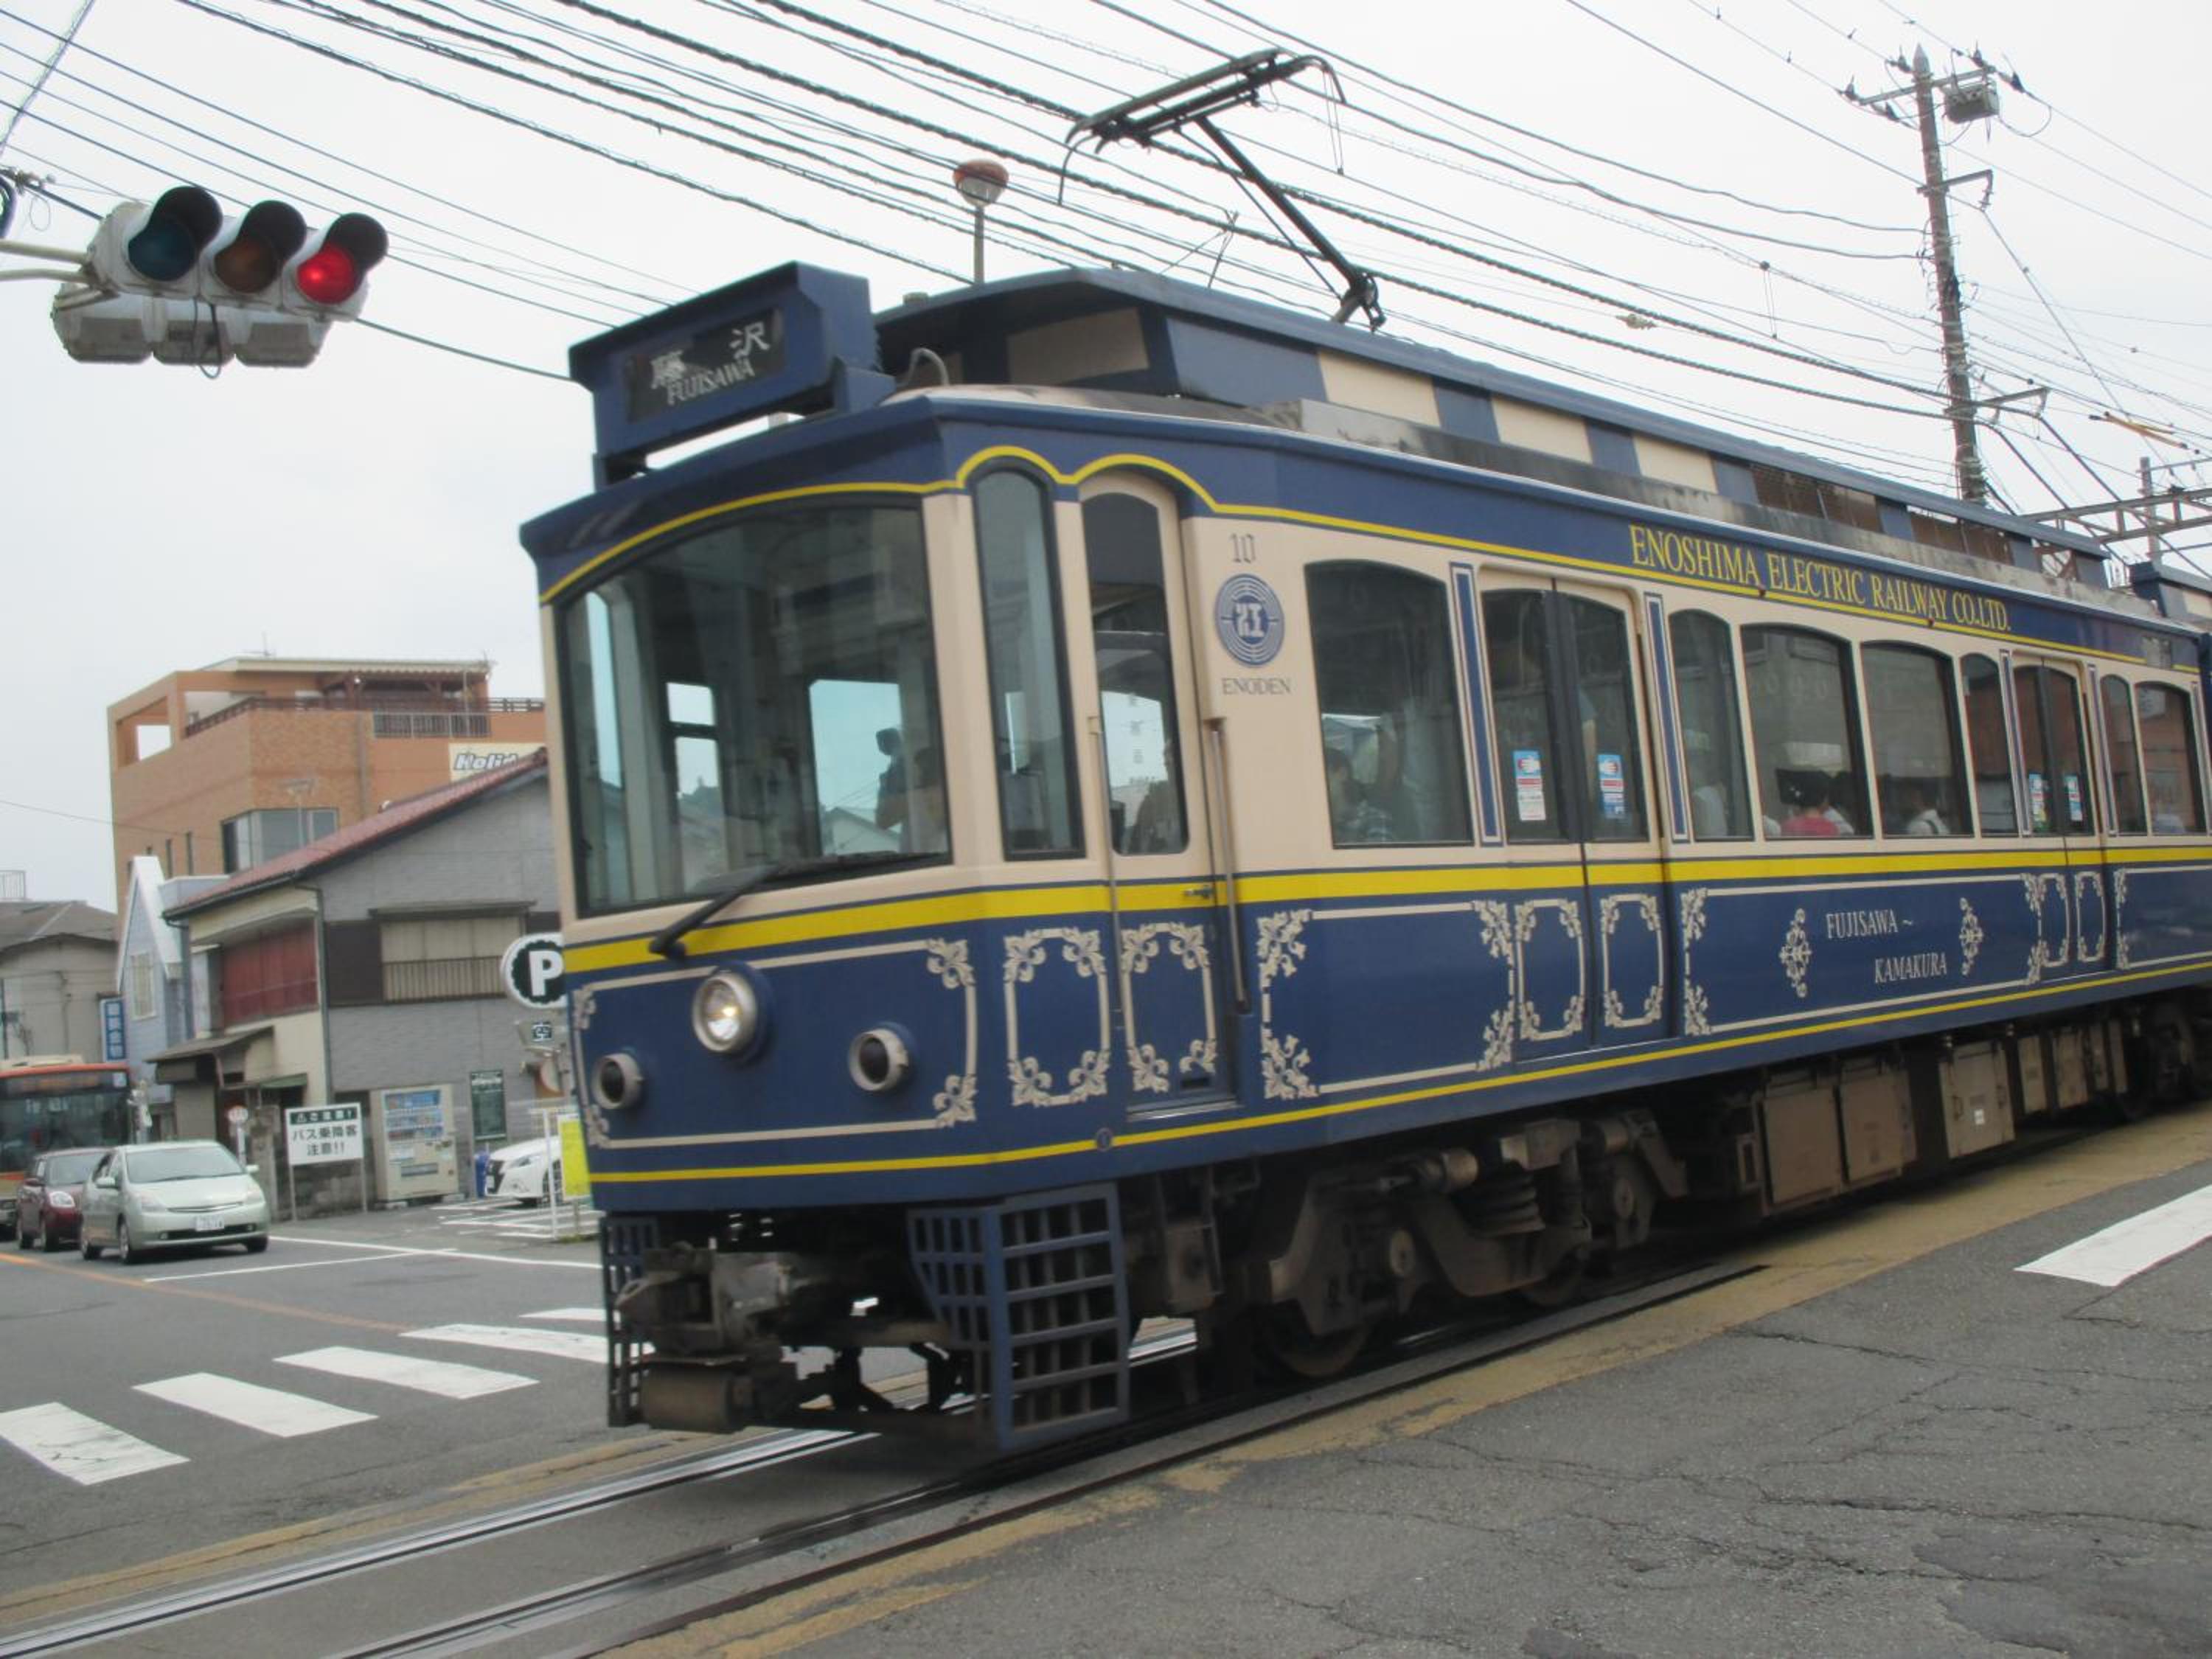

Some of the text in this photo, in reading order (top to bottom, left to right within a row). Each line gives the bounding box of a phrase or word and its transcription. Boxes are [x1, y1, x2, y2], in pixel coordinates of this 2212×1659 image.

[1228, 533, 1256, 564] 10
[1629, 523, 1760, 586] ENOSHIMA
[1767, 553, 1866, 605] ELECTRIC
[1869, 572, 1948, 620] RAILWAY
[1222, 678, 1292, 695] ENODEN
[1826, 908, 1898, 939] FUJISAWA
[529, 950, 563, 996] P
[1874, 952, 1948, 984] KAMAKURA
